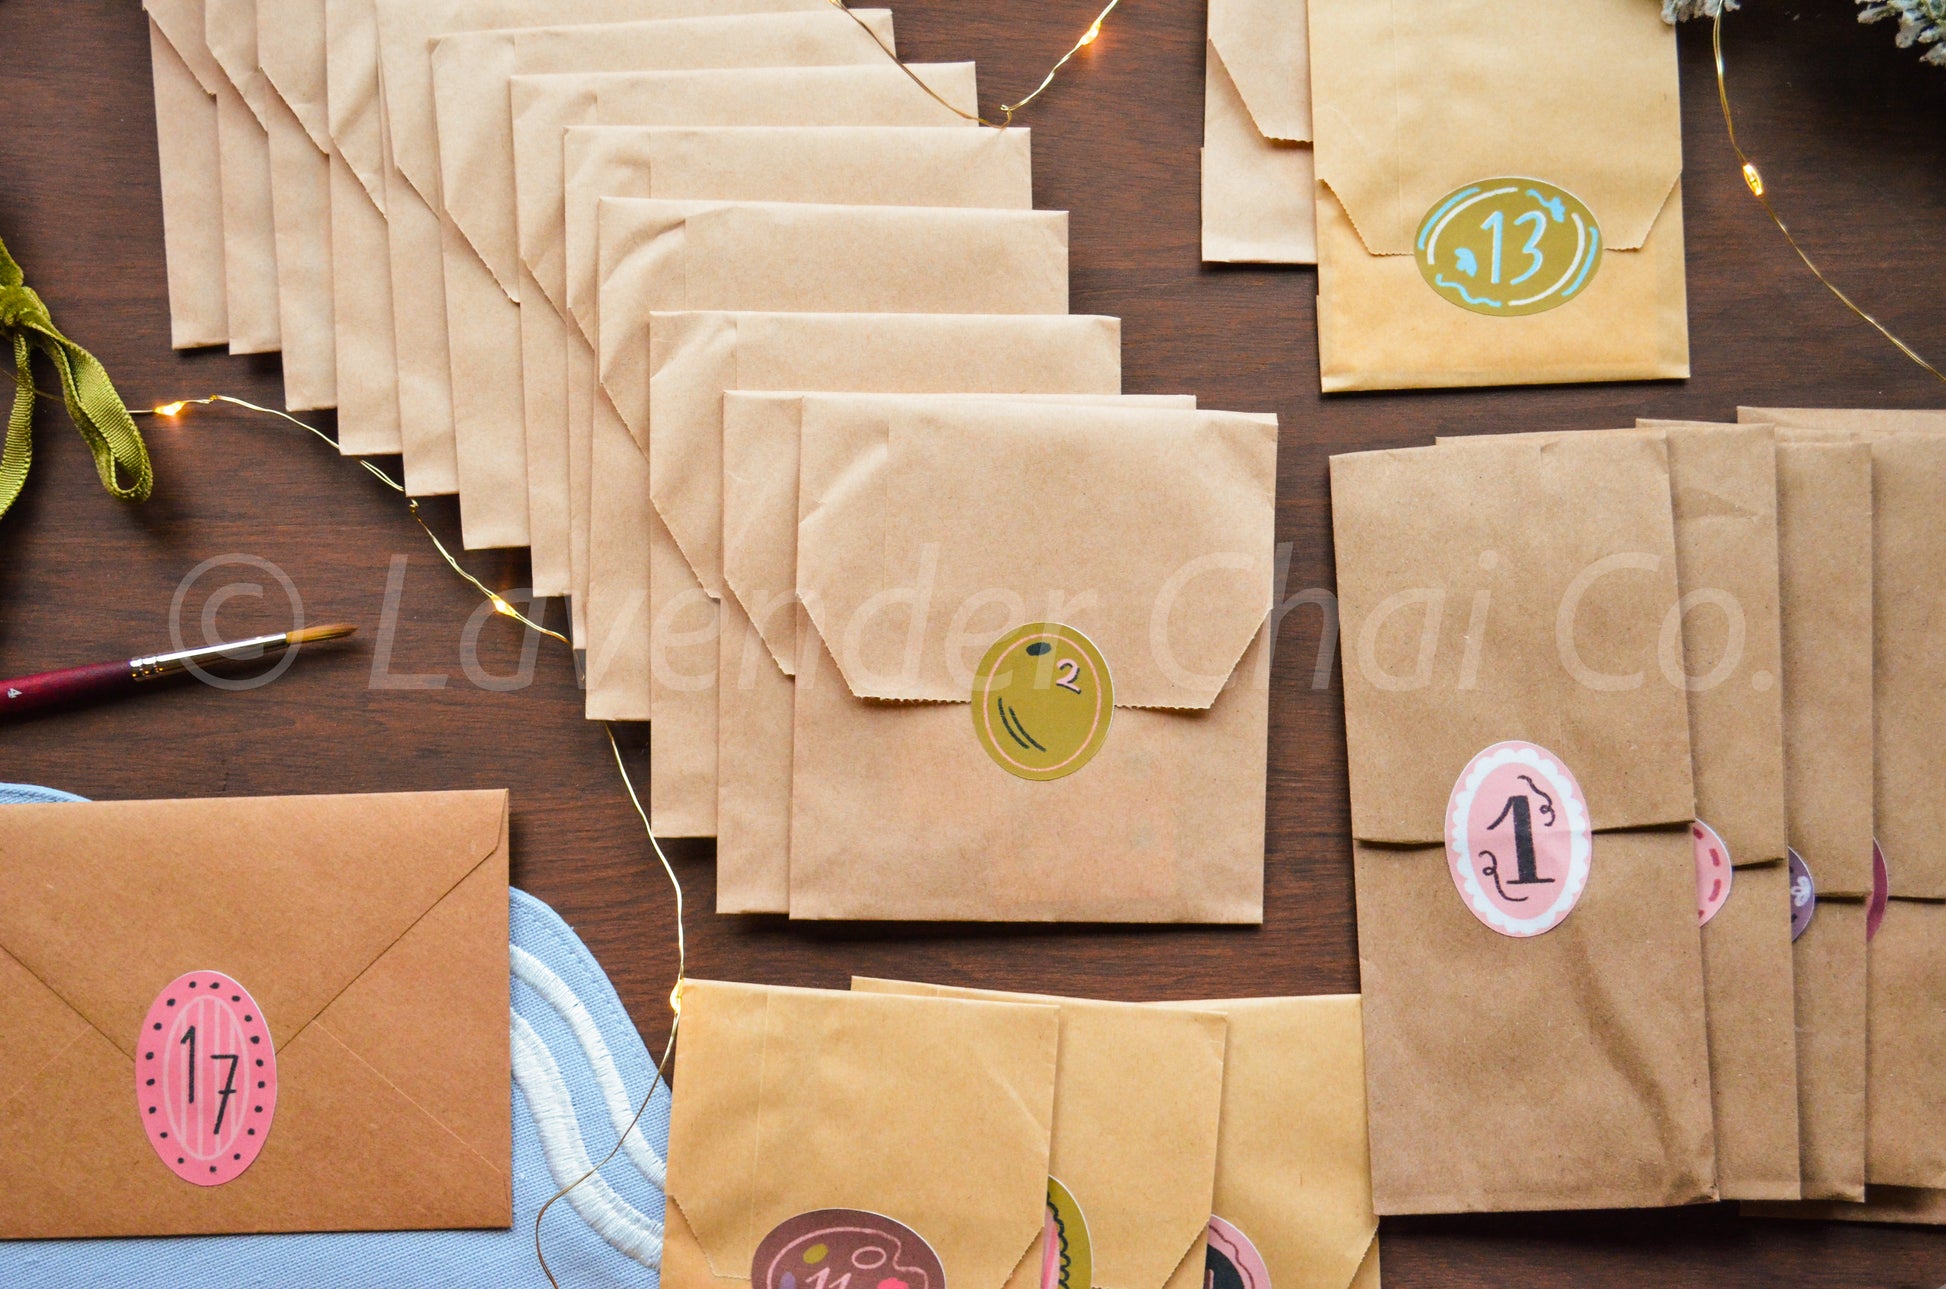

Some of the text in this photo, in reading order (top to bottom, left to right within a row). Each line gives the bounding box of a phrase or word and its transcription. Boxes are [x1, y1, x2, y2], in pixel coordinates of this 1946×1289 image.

[1480, 210, 1547, 285] 13
[1055, 657, 1082, 695] 2
[1486, 795, 1555, 884] 1
[180, 1025, 239, 1135] 17
